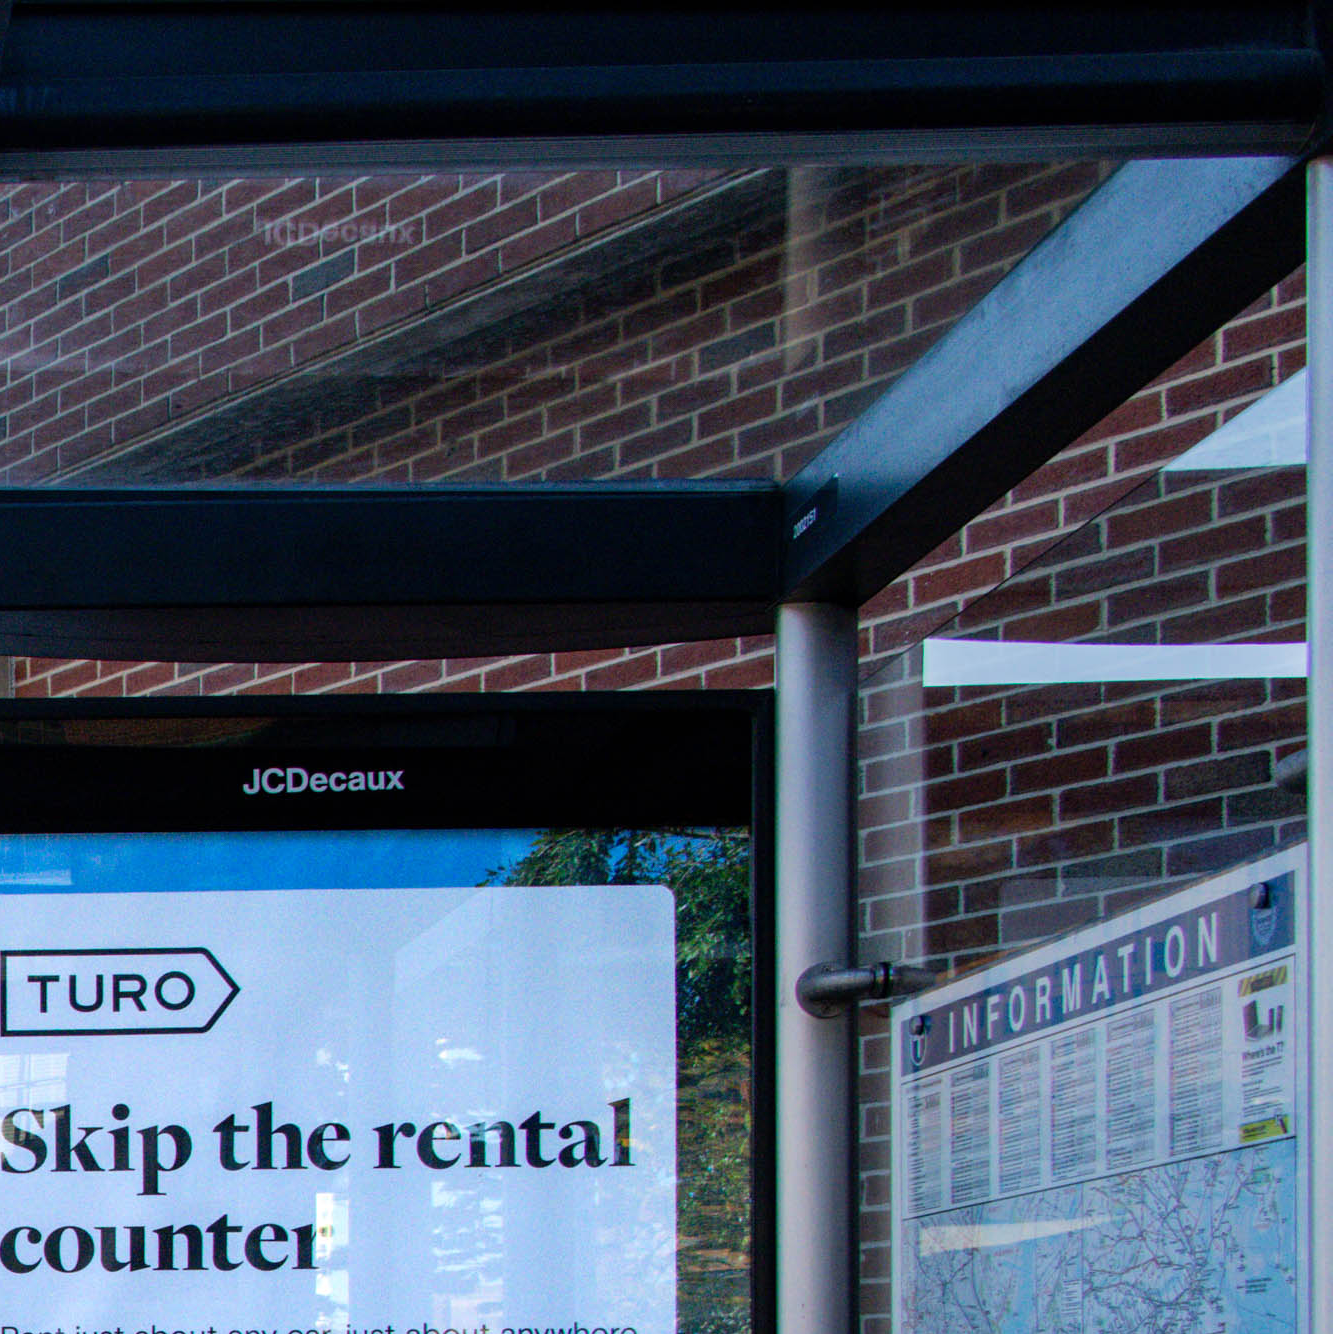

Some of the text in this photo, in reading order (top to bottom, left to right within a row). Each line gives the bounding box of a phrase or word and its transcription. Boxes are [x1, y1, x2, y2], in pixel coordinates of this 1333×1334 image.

[243, 768, 403, 794] JCDecaux
[28, 973, 195, 1014] TURO
[949, 911, 1220, 1054] INFORMATION
[0, 1097, 635, 1196] Skip the rental
[0, 1212, 333, 1274] counter
